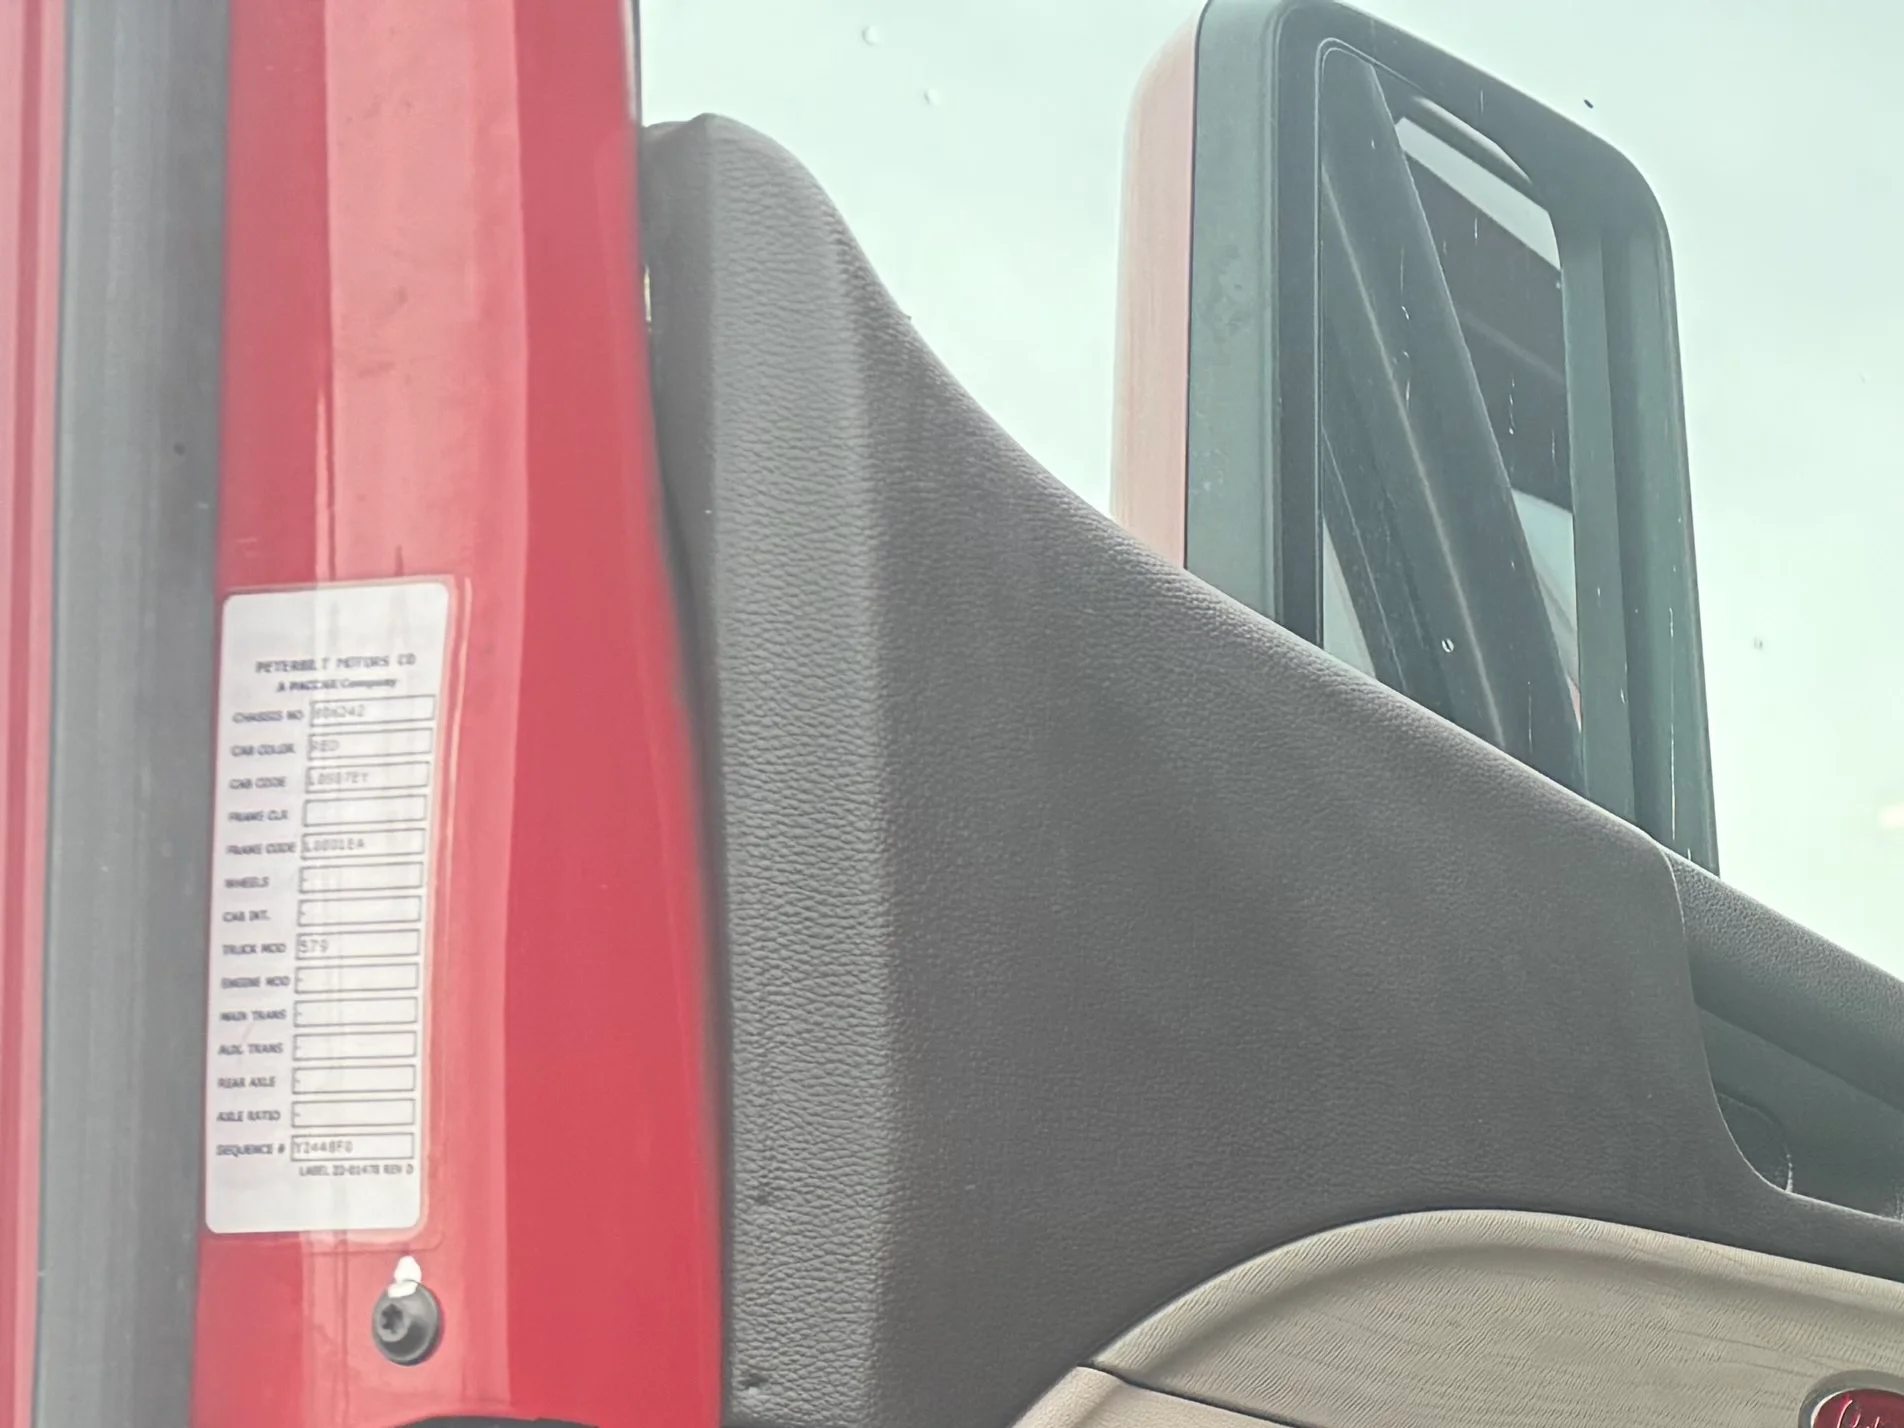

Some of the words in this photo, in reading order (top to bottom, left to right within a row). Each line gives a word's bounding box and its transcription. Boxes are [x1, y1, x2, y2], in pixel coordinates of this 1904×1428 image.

[255, 657, 331, 674] PETERBILT
[336, 655, 390, 670] MOTORS
[277, 681, 286, 693] A
[232, 710, 283, 724] CHASSIS
[225, 877, 269, 888] WHEELS
[223, 943, 257, 955] TRUCK
[299, 939, 328, 954] 579
[221, 977, 261, 988] ENGINE
[220, 1010, 247, 1021] MAIN
[252, 1009, 287, 1020] TRANS
[249, 1042, 284, 1054] TRANS
[218, 1077, 245, 1088] REAR
[250, 1076, 275, 1087] AXLE
[217, 1111, 243, 1122] AXLE
[247, 1110, 280, 1121] RATIO
[216, 1144, 273, 1157] SEQUENCE
[299, 1165, 330, 1177] LABEL
